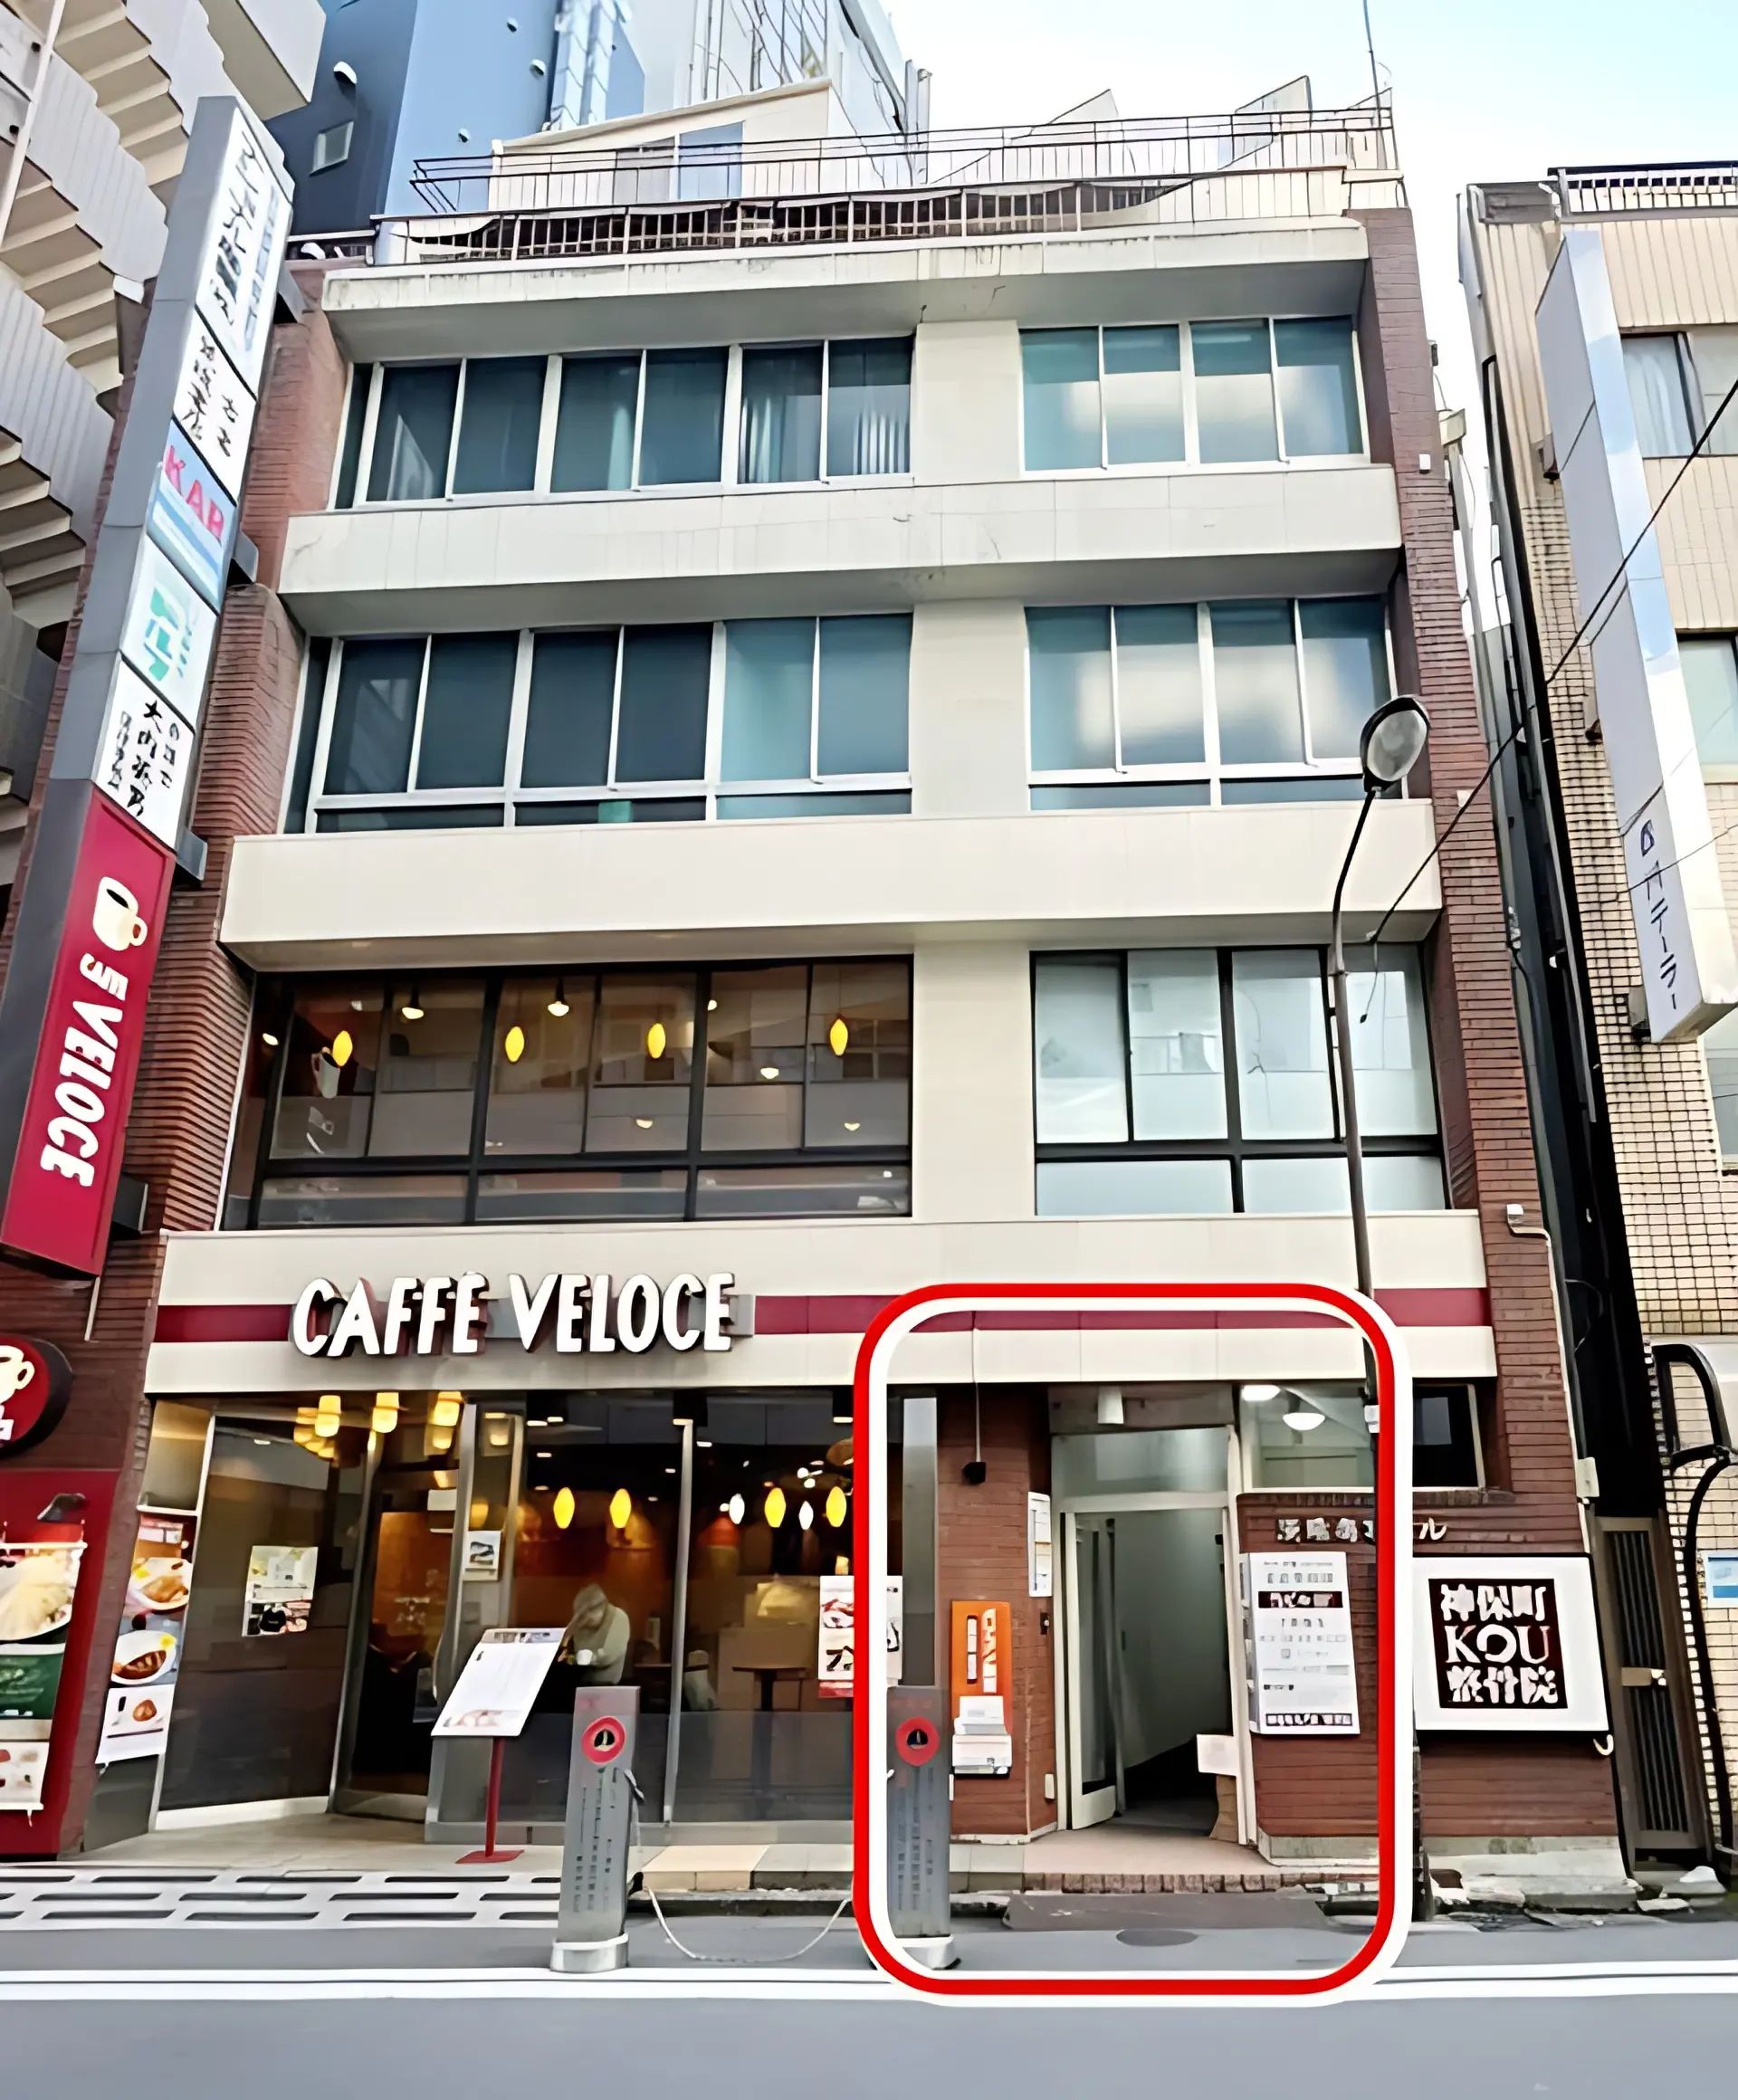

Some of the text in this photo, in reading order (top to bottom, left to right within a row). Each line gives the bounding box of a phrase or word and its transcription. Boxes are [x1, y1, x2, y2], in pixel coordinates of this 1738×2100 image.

[39, 1000, 124, 1187] VELOCE
[510, 1272, 737, 1354] VELOCE
[1444, 1623, 1551, 1665] KOU
